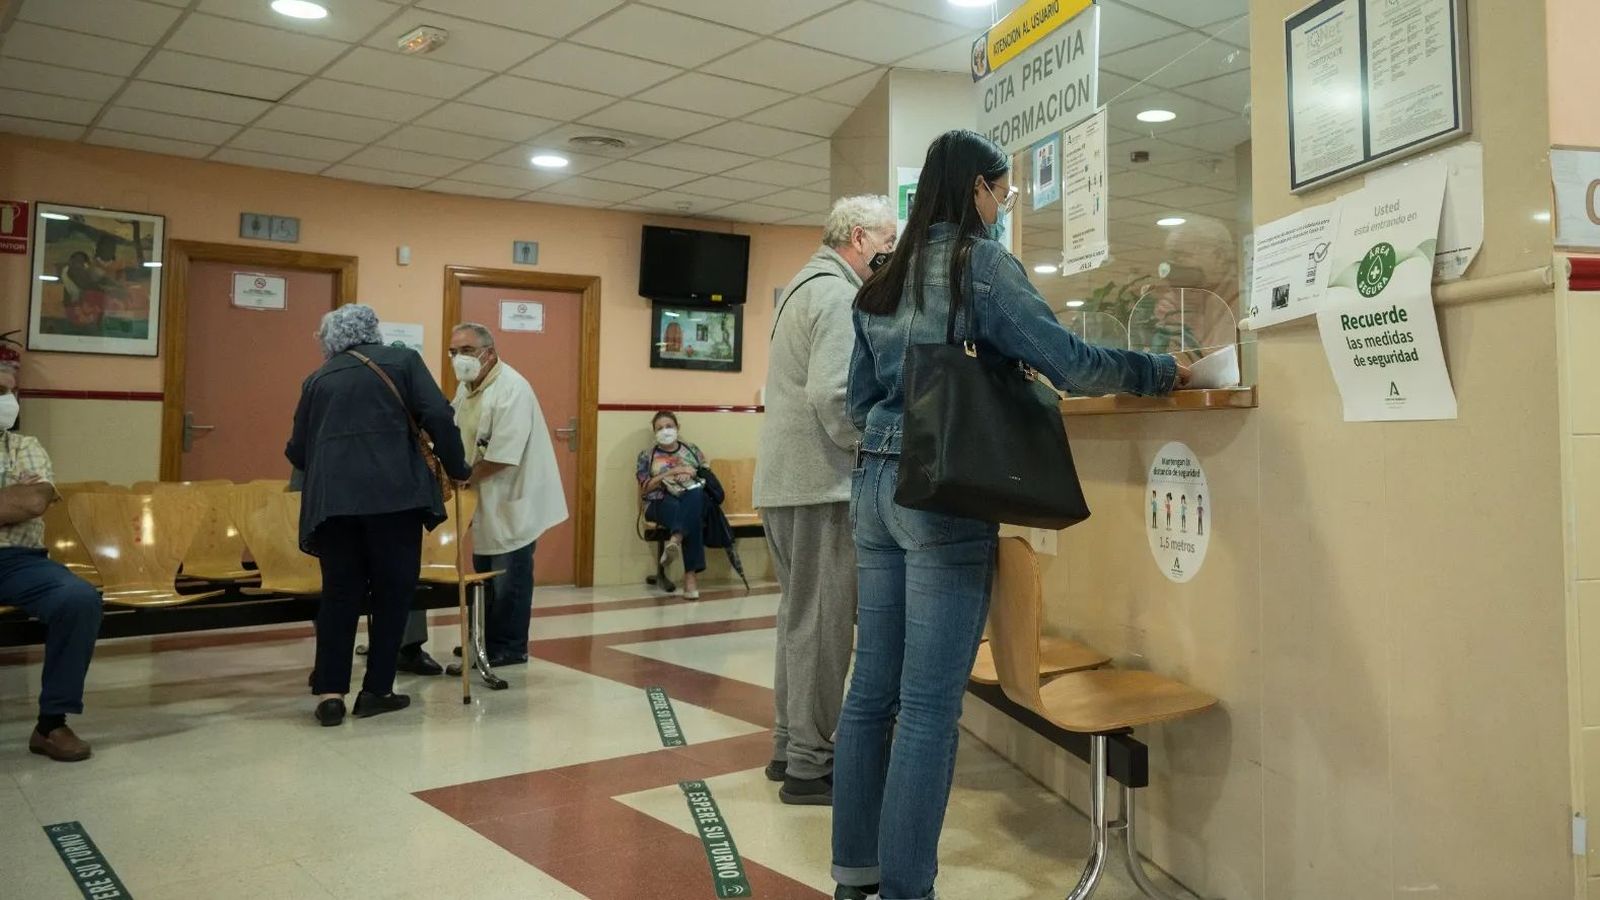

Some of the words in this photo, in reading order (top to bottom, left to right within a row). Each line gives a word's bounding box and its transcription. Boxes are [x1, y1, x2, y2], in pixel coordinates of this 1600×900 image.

[993, 28, 1021, 56] ATENCION
[1022, 21, 1031, 36] AL
[1032, 0, 1059, 29] USUARIO
[984, 75, 1015, 113] CITA
[1022, 29, 1084, 92] PREVIA
[984, 74, 1090, 147] FORMACION
[1374, 199, 1400, 217] Usted
[1354, 222, 1370, 236] está
[1370, 215, 1406, 232] entrando
[1407, 211, 1418, 222] en
[1359, 277, 1389, 295] SEGURA
[1340, 305, 1408, 331] Recuerde
[1346, 336, 1363, 350] las
[1364, 330, 1414, 348] medidas
[1353, 354, 1366, 367] de
[1366, 348, 1419, 368] seguridad
[1160, 536, 1170, 550] 1,5
[1171, 540, 1196, 553] metros
[650, 692, 669, 710] ESPERE
[657, 710, 671, 718] SU
[660, 718, 679, 738] TURNO
[688, 791, 719, 824] ESPERE
[703, 825, 725, 839] SU
[57, 834, 96, 864] TURNO
[709, 840, 740, 879] TURNO
[75, 863, 106, 878] SU
